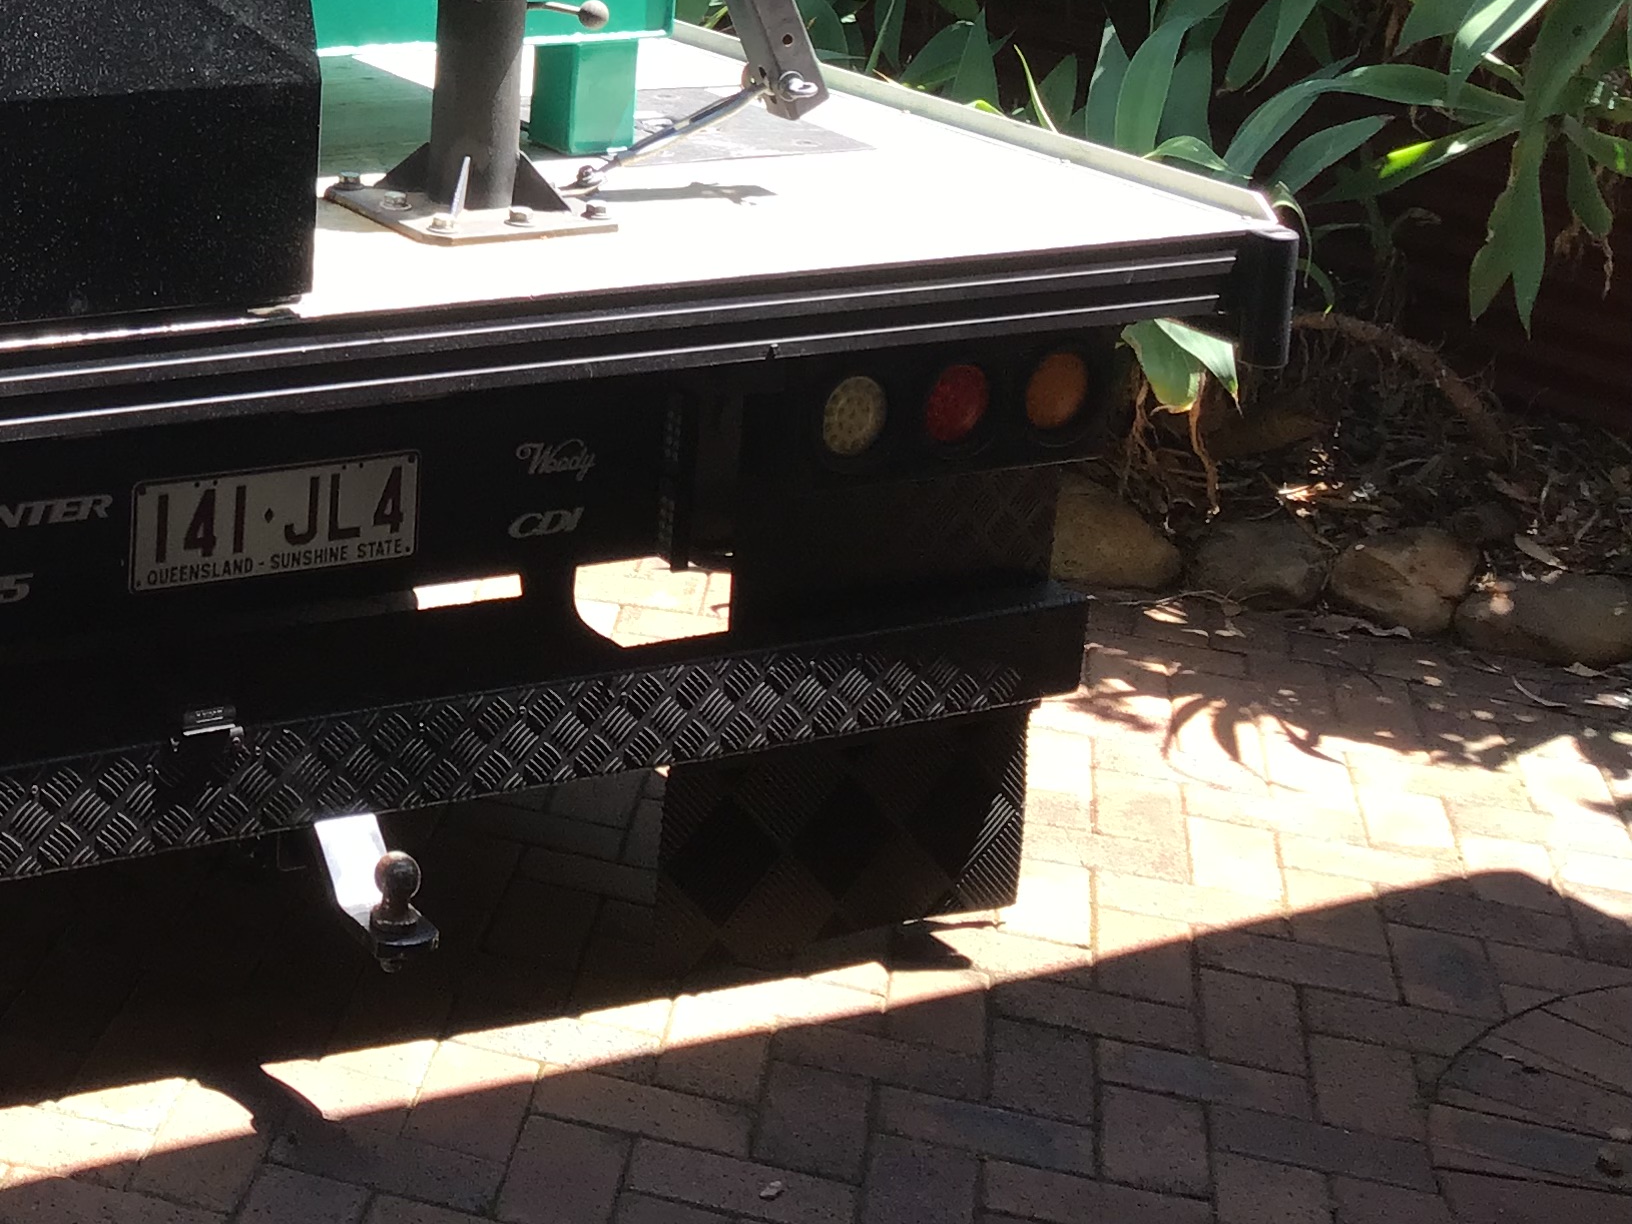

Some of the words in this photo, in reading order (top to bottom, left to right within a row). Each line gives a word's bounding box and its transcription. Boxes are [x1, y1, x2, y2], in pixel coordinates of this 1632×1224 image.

[507, 506, 585, 539] CDI
[146, 557, 254, 586] QUEENSLAND
[270, 545, 348, 570] SUNSHINE
[357, 538, 403, 561] STATE
